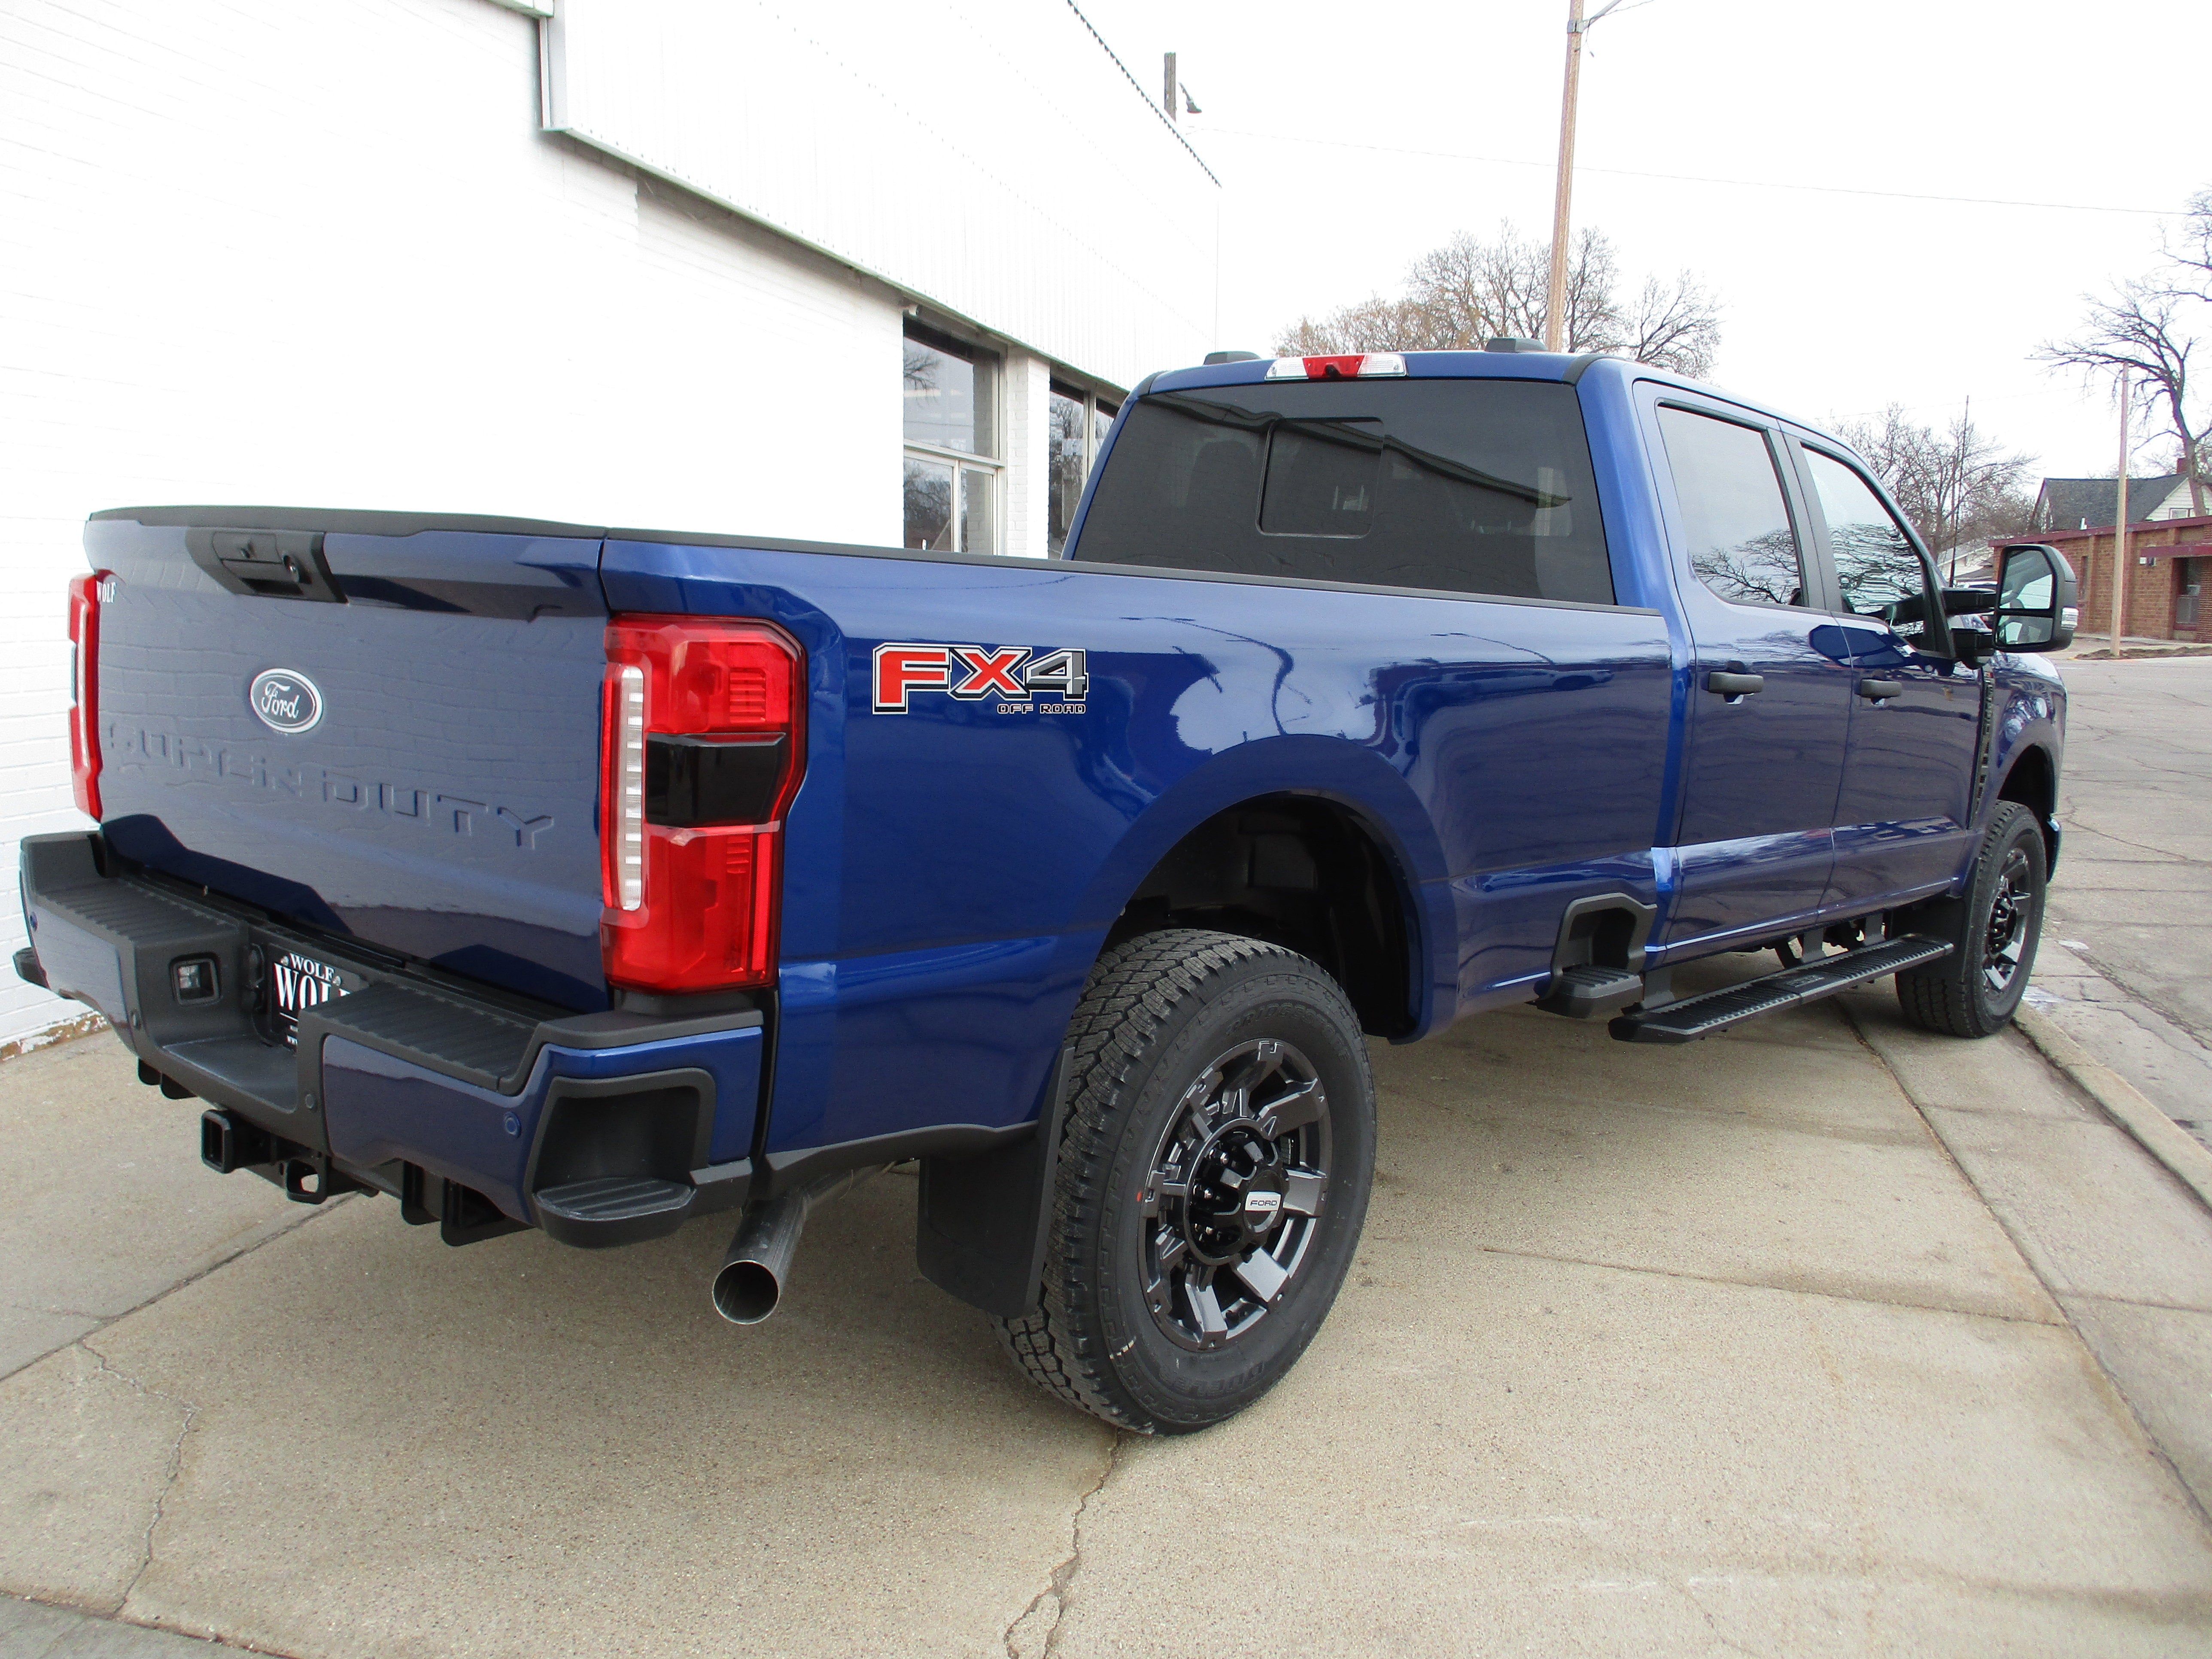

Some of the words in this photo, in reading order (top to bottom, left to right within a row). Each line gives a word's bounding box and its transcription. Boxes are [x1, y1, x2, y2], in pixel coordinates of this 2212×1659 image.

[96, 580, 116, 603] WOLF
[872, 643, 1089, 714] FX4
[261, 681, 301, 719] Ford
[997, 703, 1034, 714] OFF
[1039, 703, 1086, 714] ROAD
[322, 770, 554, 851] DUTY
[289, 952, 335, 982] WOLF
[273, 962, 354, 1012] WO
